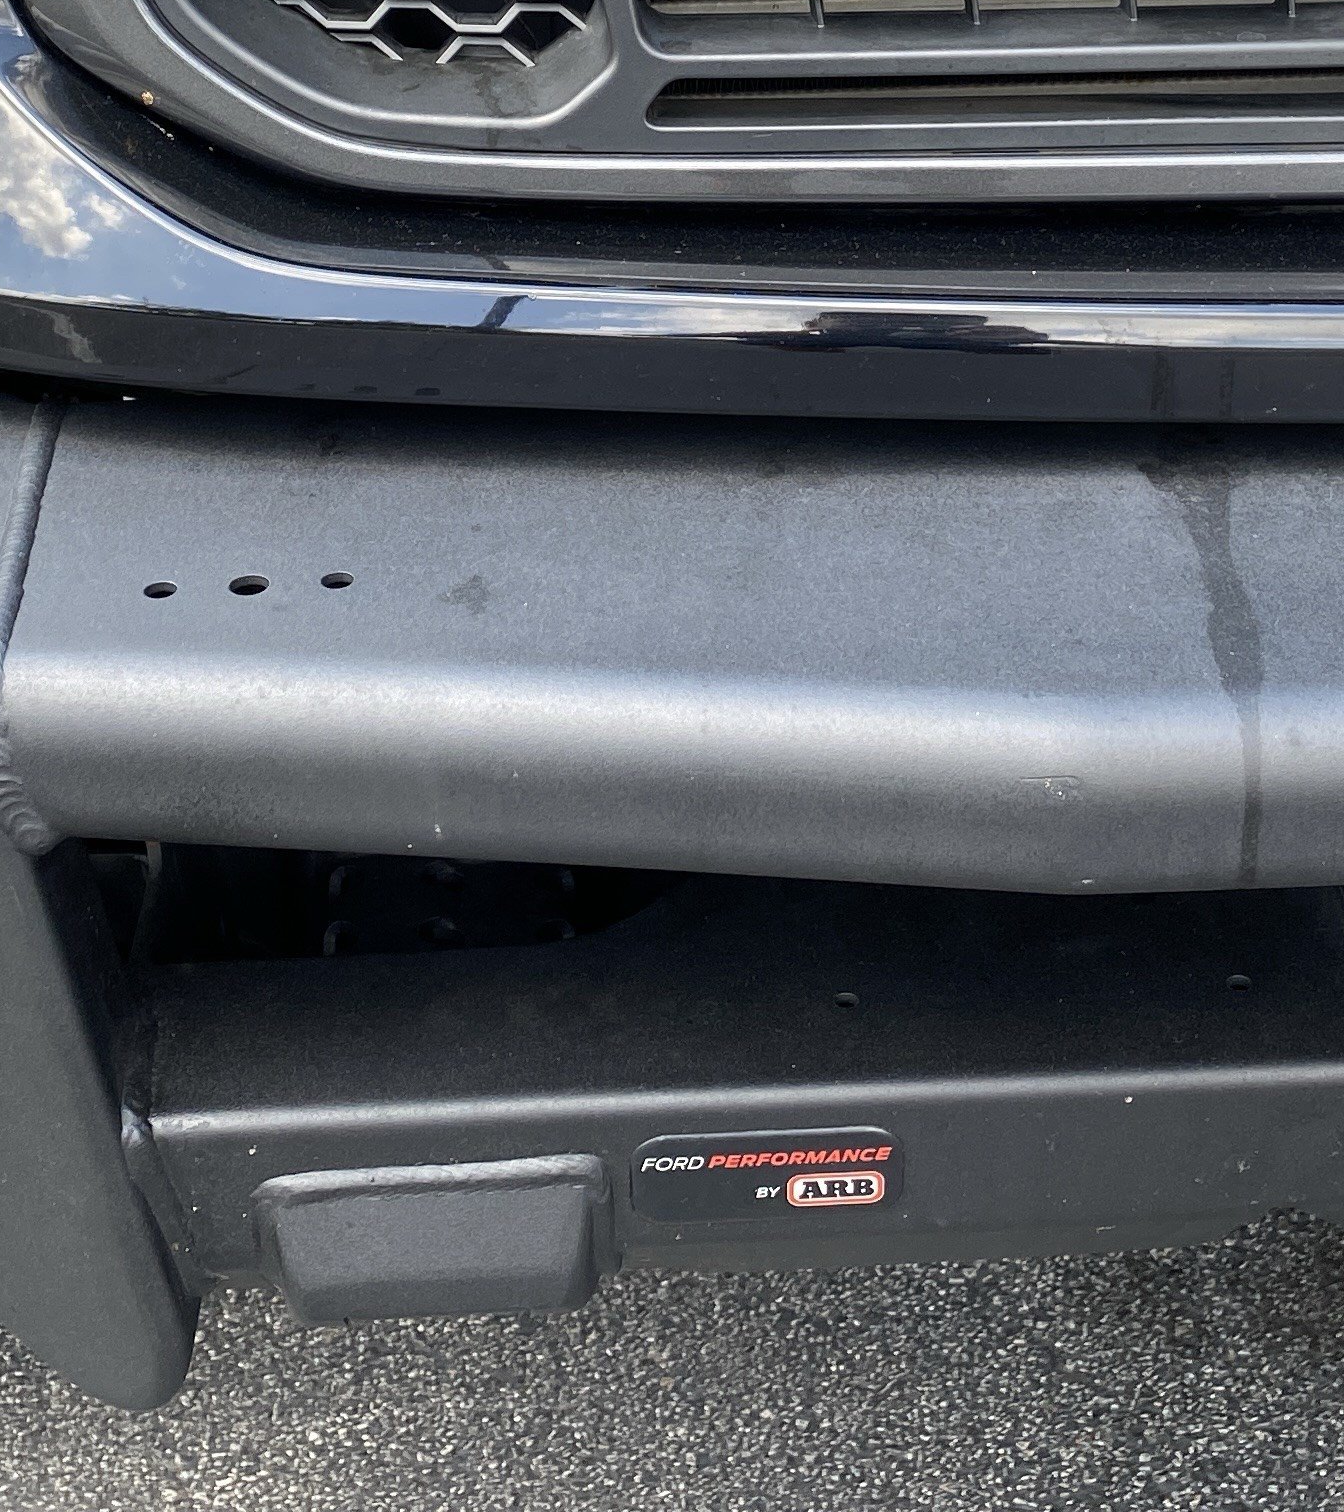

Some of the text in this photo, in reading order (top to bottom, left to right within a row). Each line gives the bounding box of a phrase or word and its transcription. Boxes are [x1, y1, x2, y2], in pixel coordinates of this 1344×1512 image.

[640, 1146, 893, 1172] FORD PERFORMANCE
[756, 1178, 875, 1200] BY ARB
